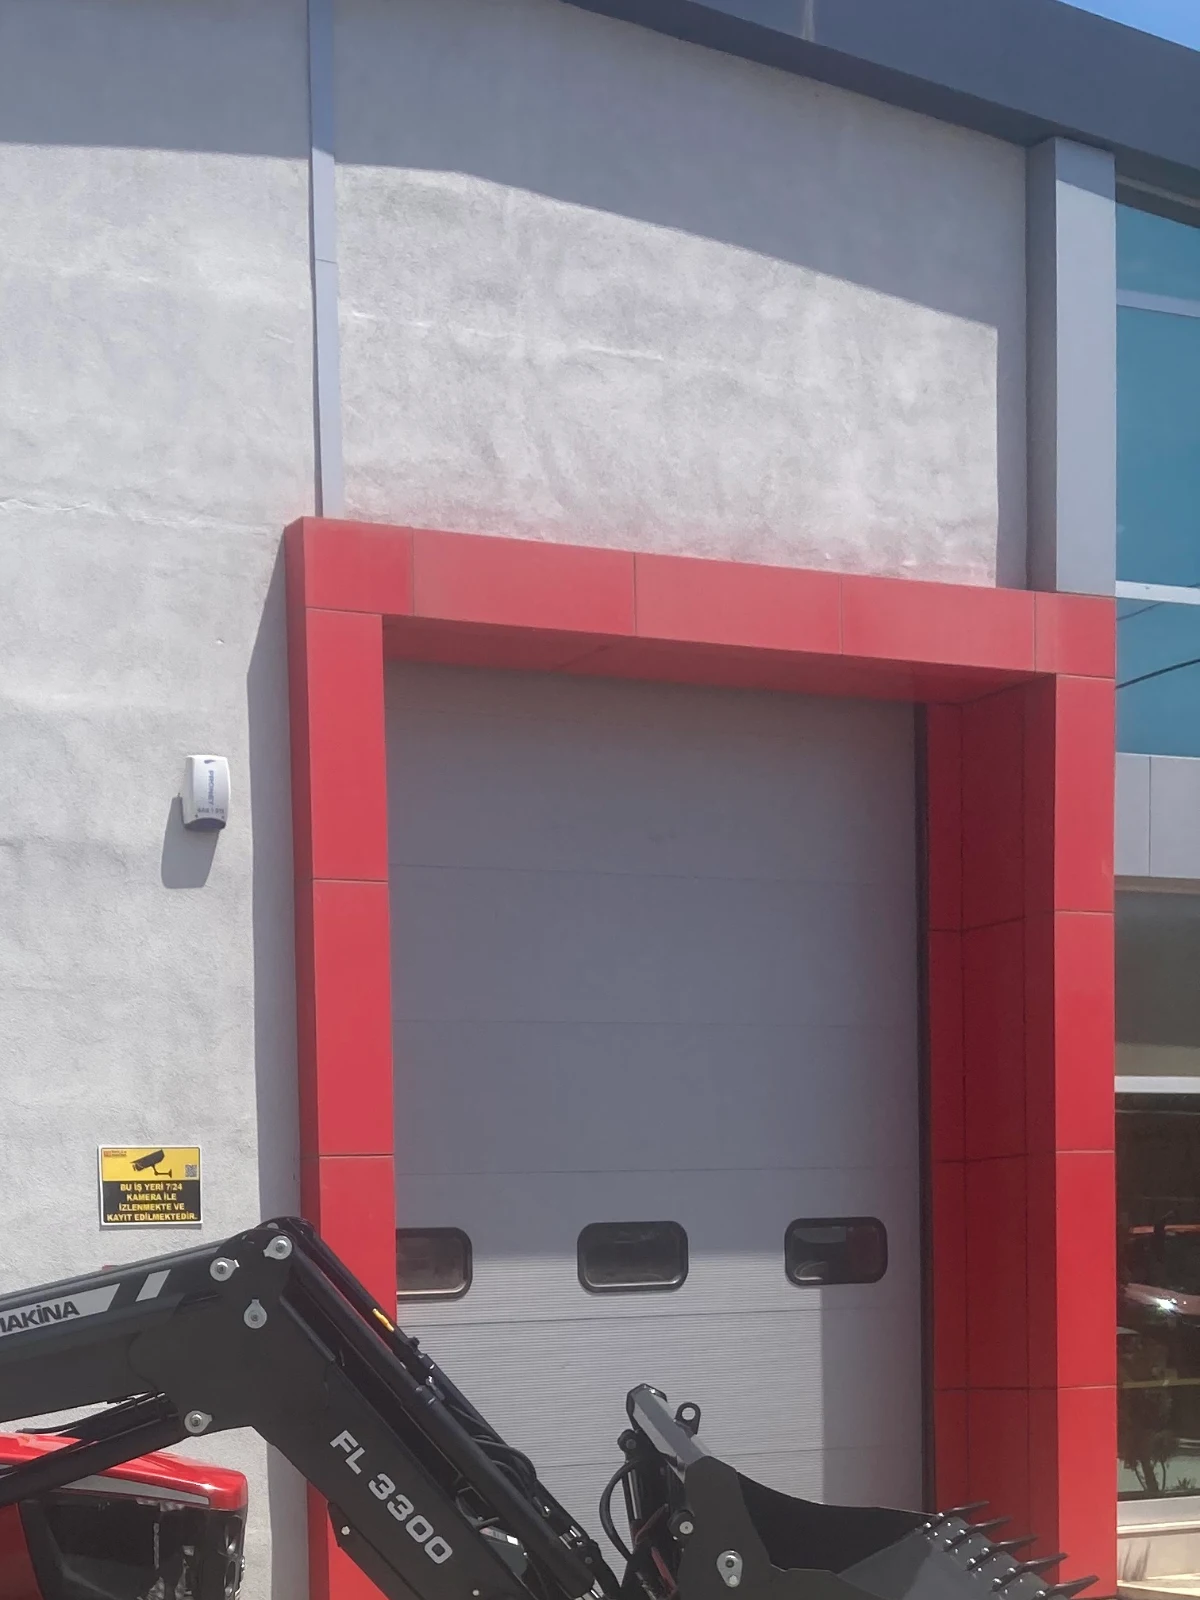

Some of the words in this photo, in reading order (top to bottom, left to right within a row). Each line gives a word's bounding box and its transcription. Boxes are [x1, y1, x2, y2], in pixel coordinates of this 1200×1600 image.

[120, 1183, 132, 1191] BU
[134, 1182, 142, 1192] İŞ
[144, 1182, 164, 1191] YERİ
[126, 1193, 162, 1201] KAMERA
[164, 1192, 177, 1201] İLE
[119, 1202, 172, 1211] İZLENMEKTE
[173, 1202, 185, 1210] VE
[107, 1213, 132, 1221] KAYIT
[329, 1430, 365, 1475] FL
[368, 1473, 453, 1564] 3300
